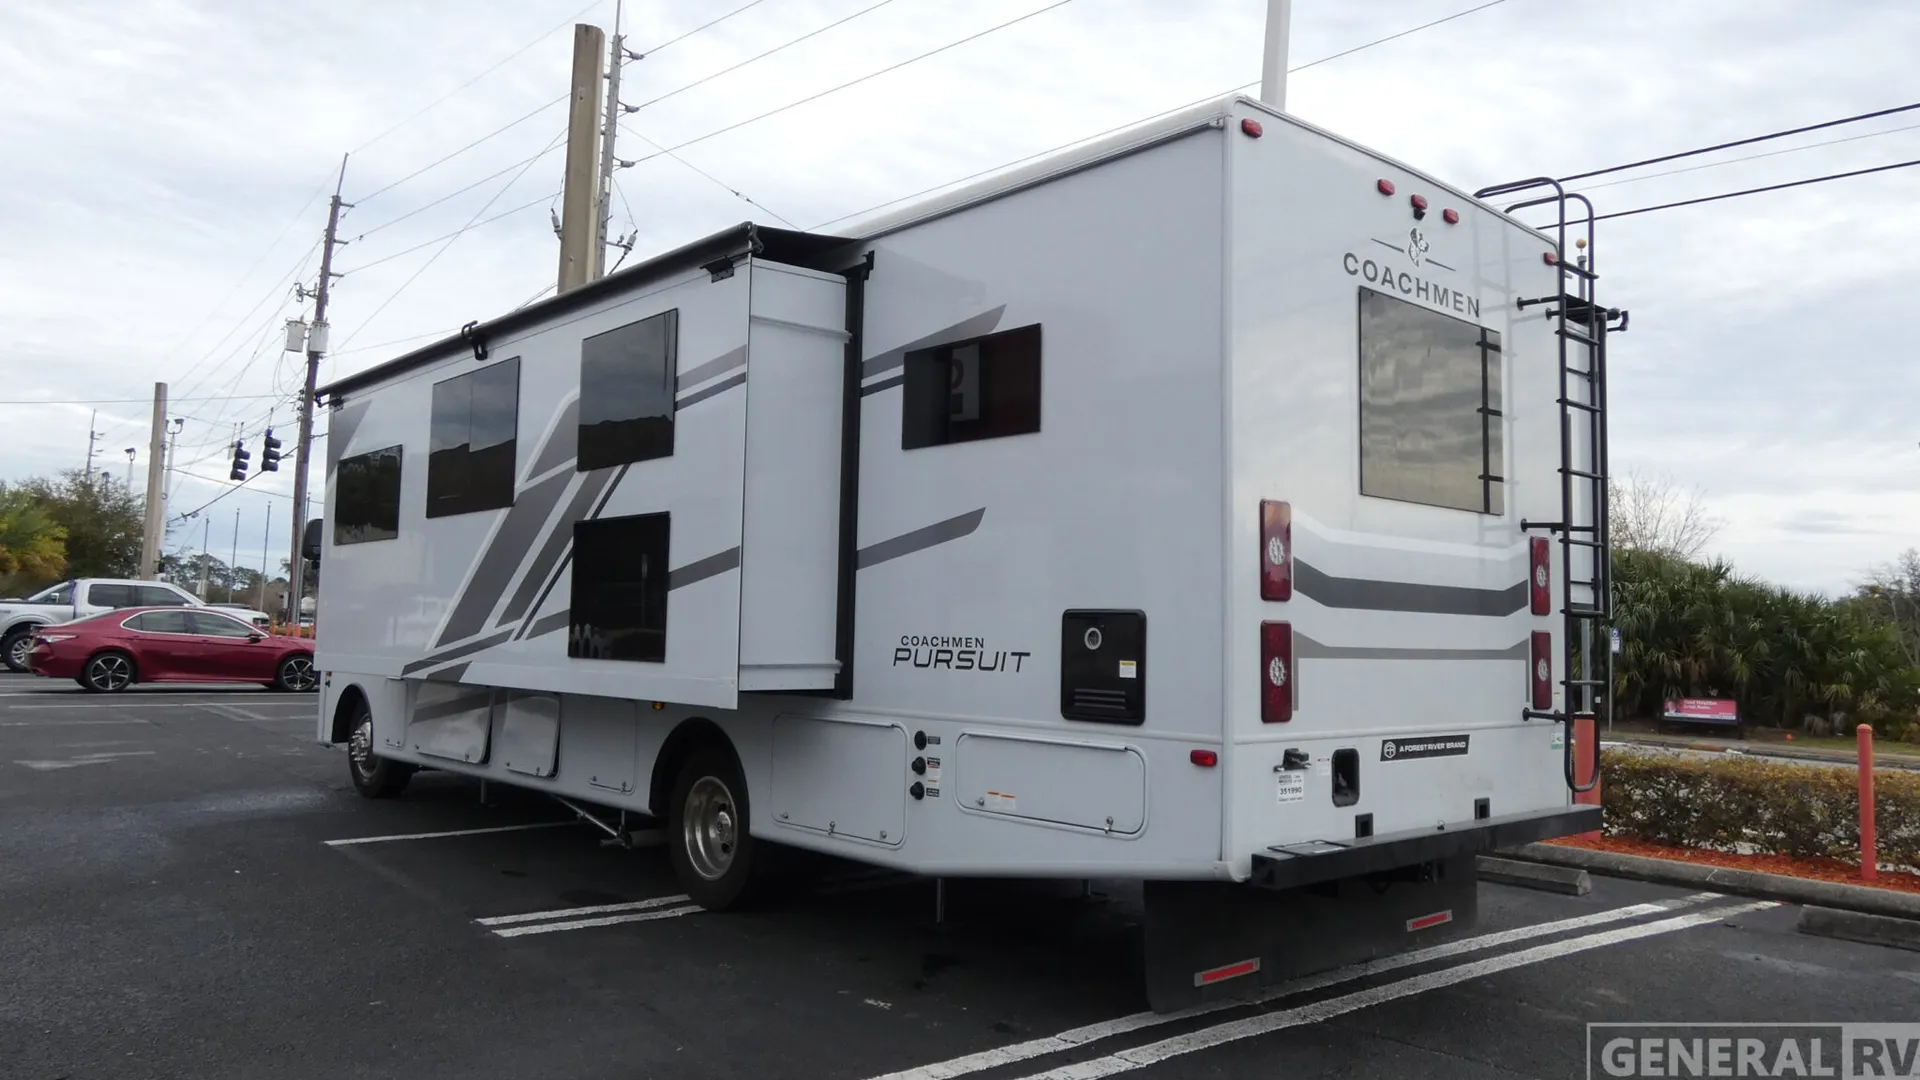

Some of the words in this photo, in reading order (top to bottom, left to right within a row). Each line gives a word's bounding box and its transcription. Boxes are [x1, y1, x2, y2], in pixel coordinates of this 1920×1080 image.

[1343, 252, 1480, 318] COACHMEN
[900, 635, 984, 648] COACHMEN
[893, 648, 1031, 673] PURSUIT
[1399, 745, 1405, 753] A
[1446, 741, 1467, 749] BRAND
